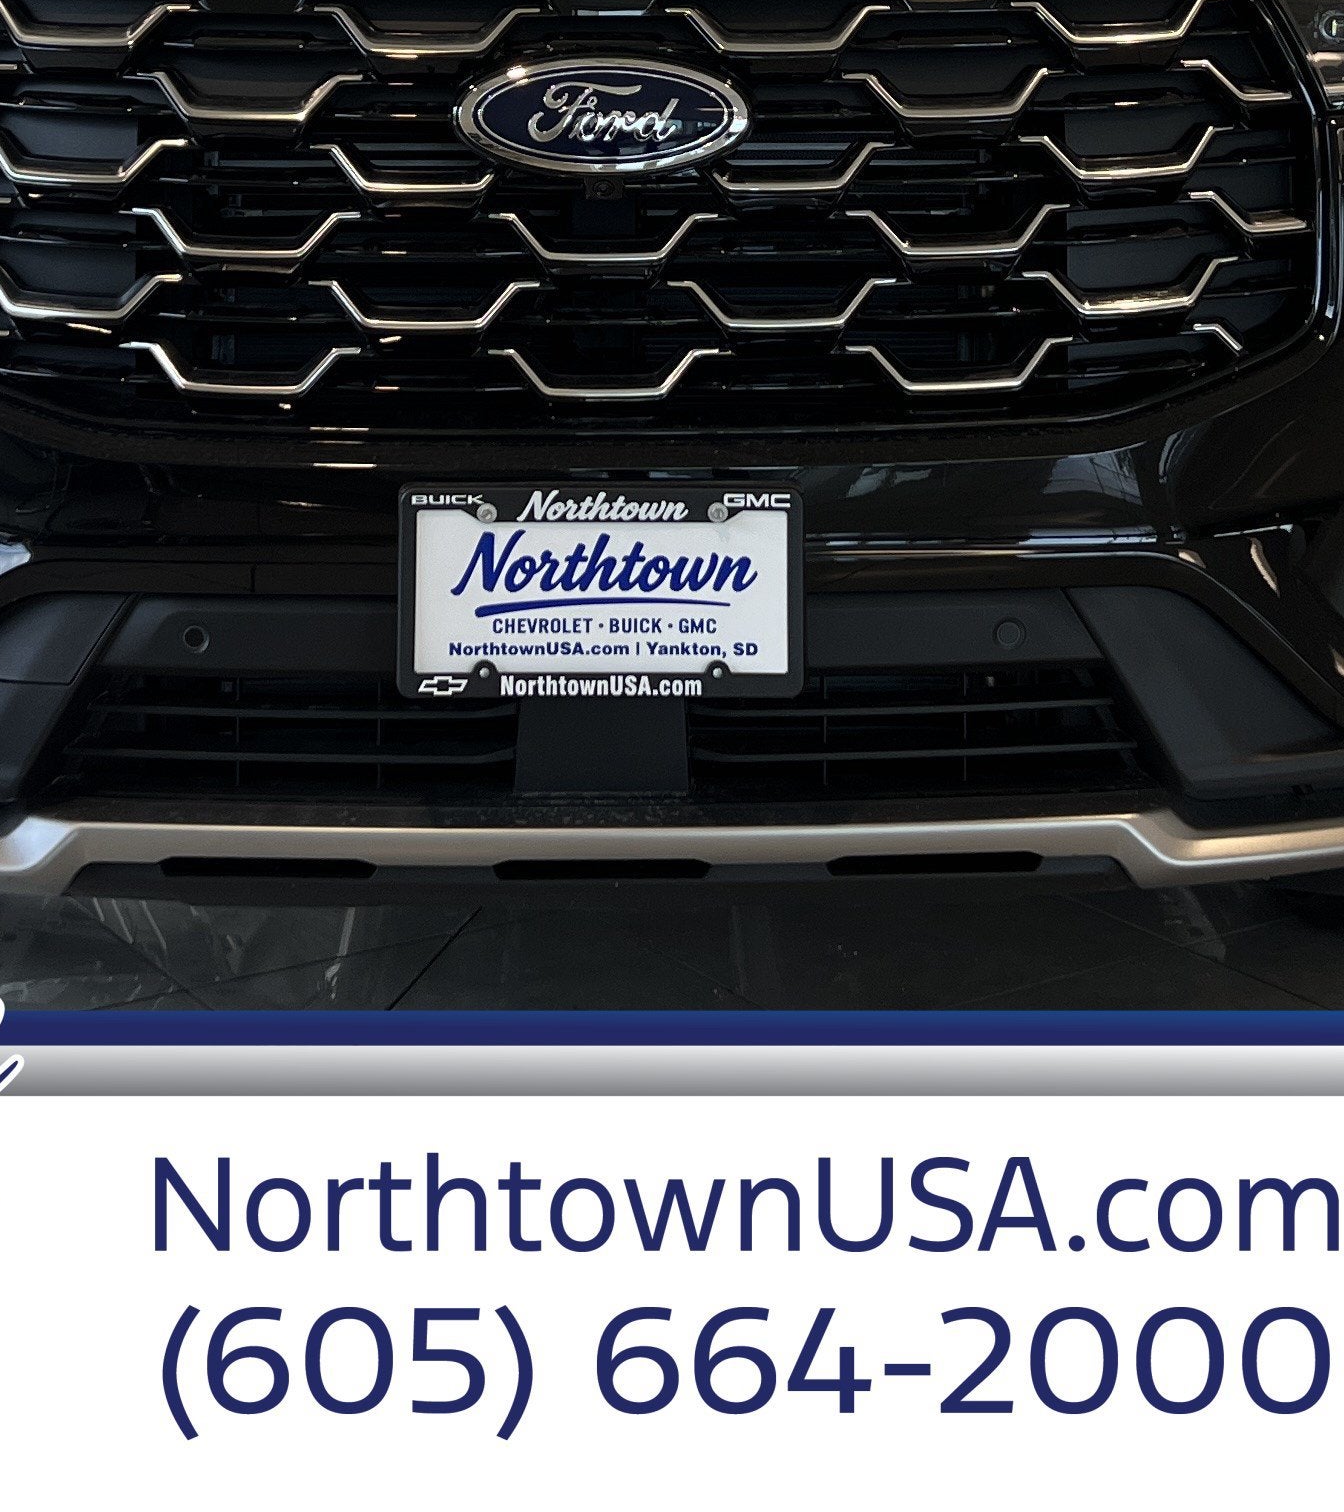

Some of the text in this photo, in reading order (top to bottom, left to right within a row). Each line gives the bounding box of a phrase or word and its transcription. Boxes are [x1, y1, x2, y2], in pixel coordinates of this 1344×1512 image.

[528, 82, 680, 142] Ford
[411, 494, 485, 506] BUICK
[516, 490, 689, 523] Northtown
[723, 493, 792, 508] GMC
[450, 529, 758, 596] Northtown
[492, 617, 718, 635] CHEVROLET BUICK GMC
[448, 641, 759, 660] NorthtownUSA.com Yankton, SD
[499, 675, 703, 697] NorthtownUSA.com
